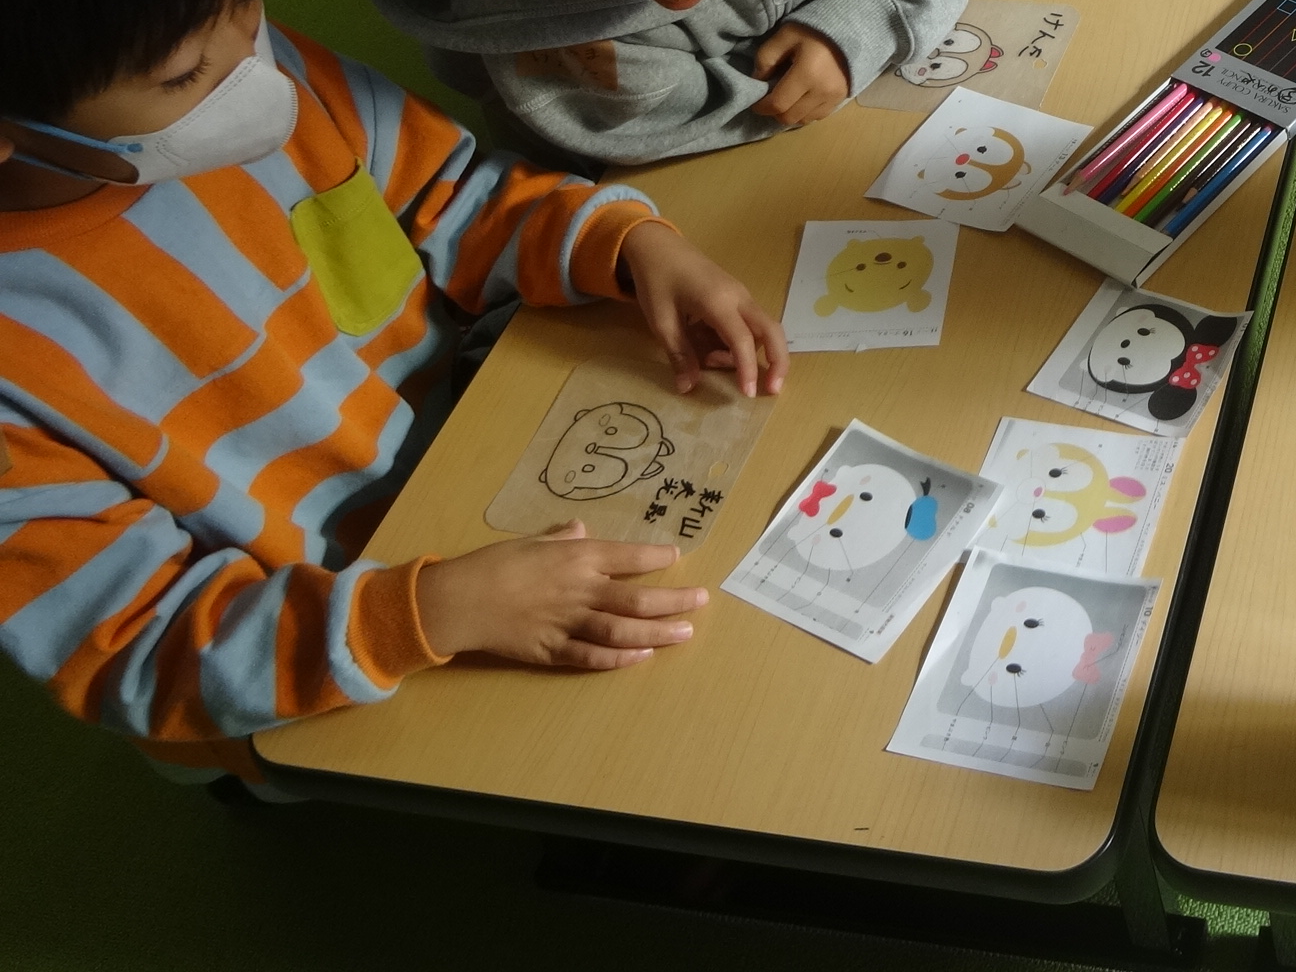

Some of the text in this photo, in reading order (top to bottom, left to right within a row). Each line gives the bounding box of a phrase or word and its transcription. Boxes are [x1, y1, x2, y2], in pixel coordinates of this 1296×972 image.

[1018, 12, 1064, 58] けんた
[1192, 60, 1212, 78] 12
[1217, 78, 1292, 114] SAKURA COUPY
[1164, 462, 1173, 472] 20
[679, 488, 724, 538] 新山
[963, 502, 974, 512] 08
[1144, 606, 1152, 616] 10
